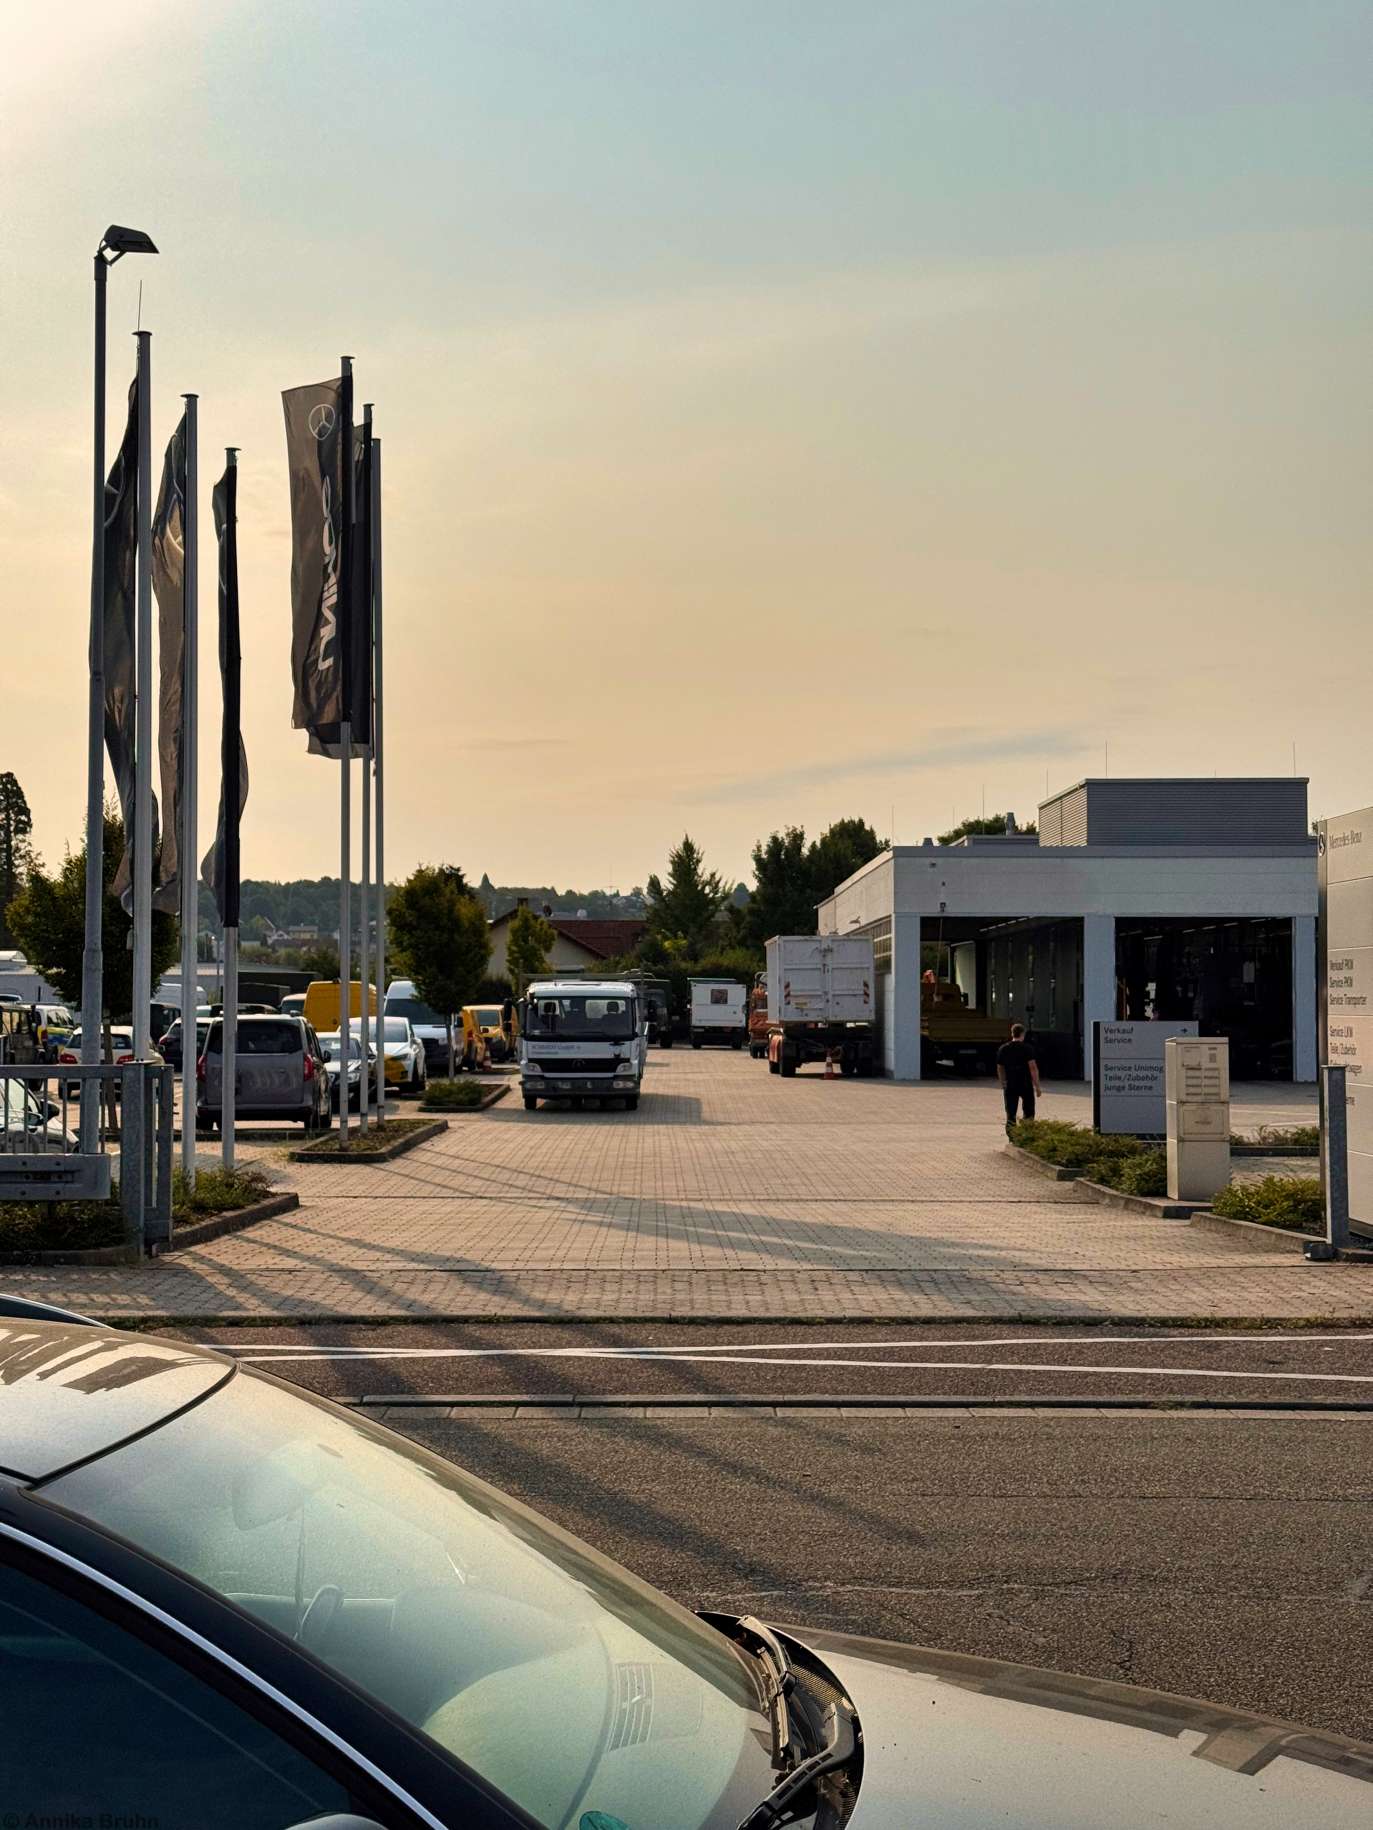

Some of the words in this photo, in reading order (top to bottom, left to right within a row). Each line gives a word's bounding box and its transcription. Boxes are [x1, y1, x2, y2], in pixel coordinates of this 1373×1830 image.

[1104, 1025, 1134, 1034] Verkauf
[1104, 1036, 1132, 1044] Service
[1104, 1063, 1132, 1072] Service
[1134, 1063, 1164, 1073] Unimog
[1128, 1083, 1153, 1091] Sterne
